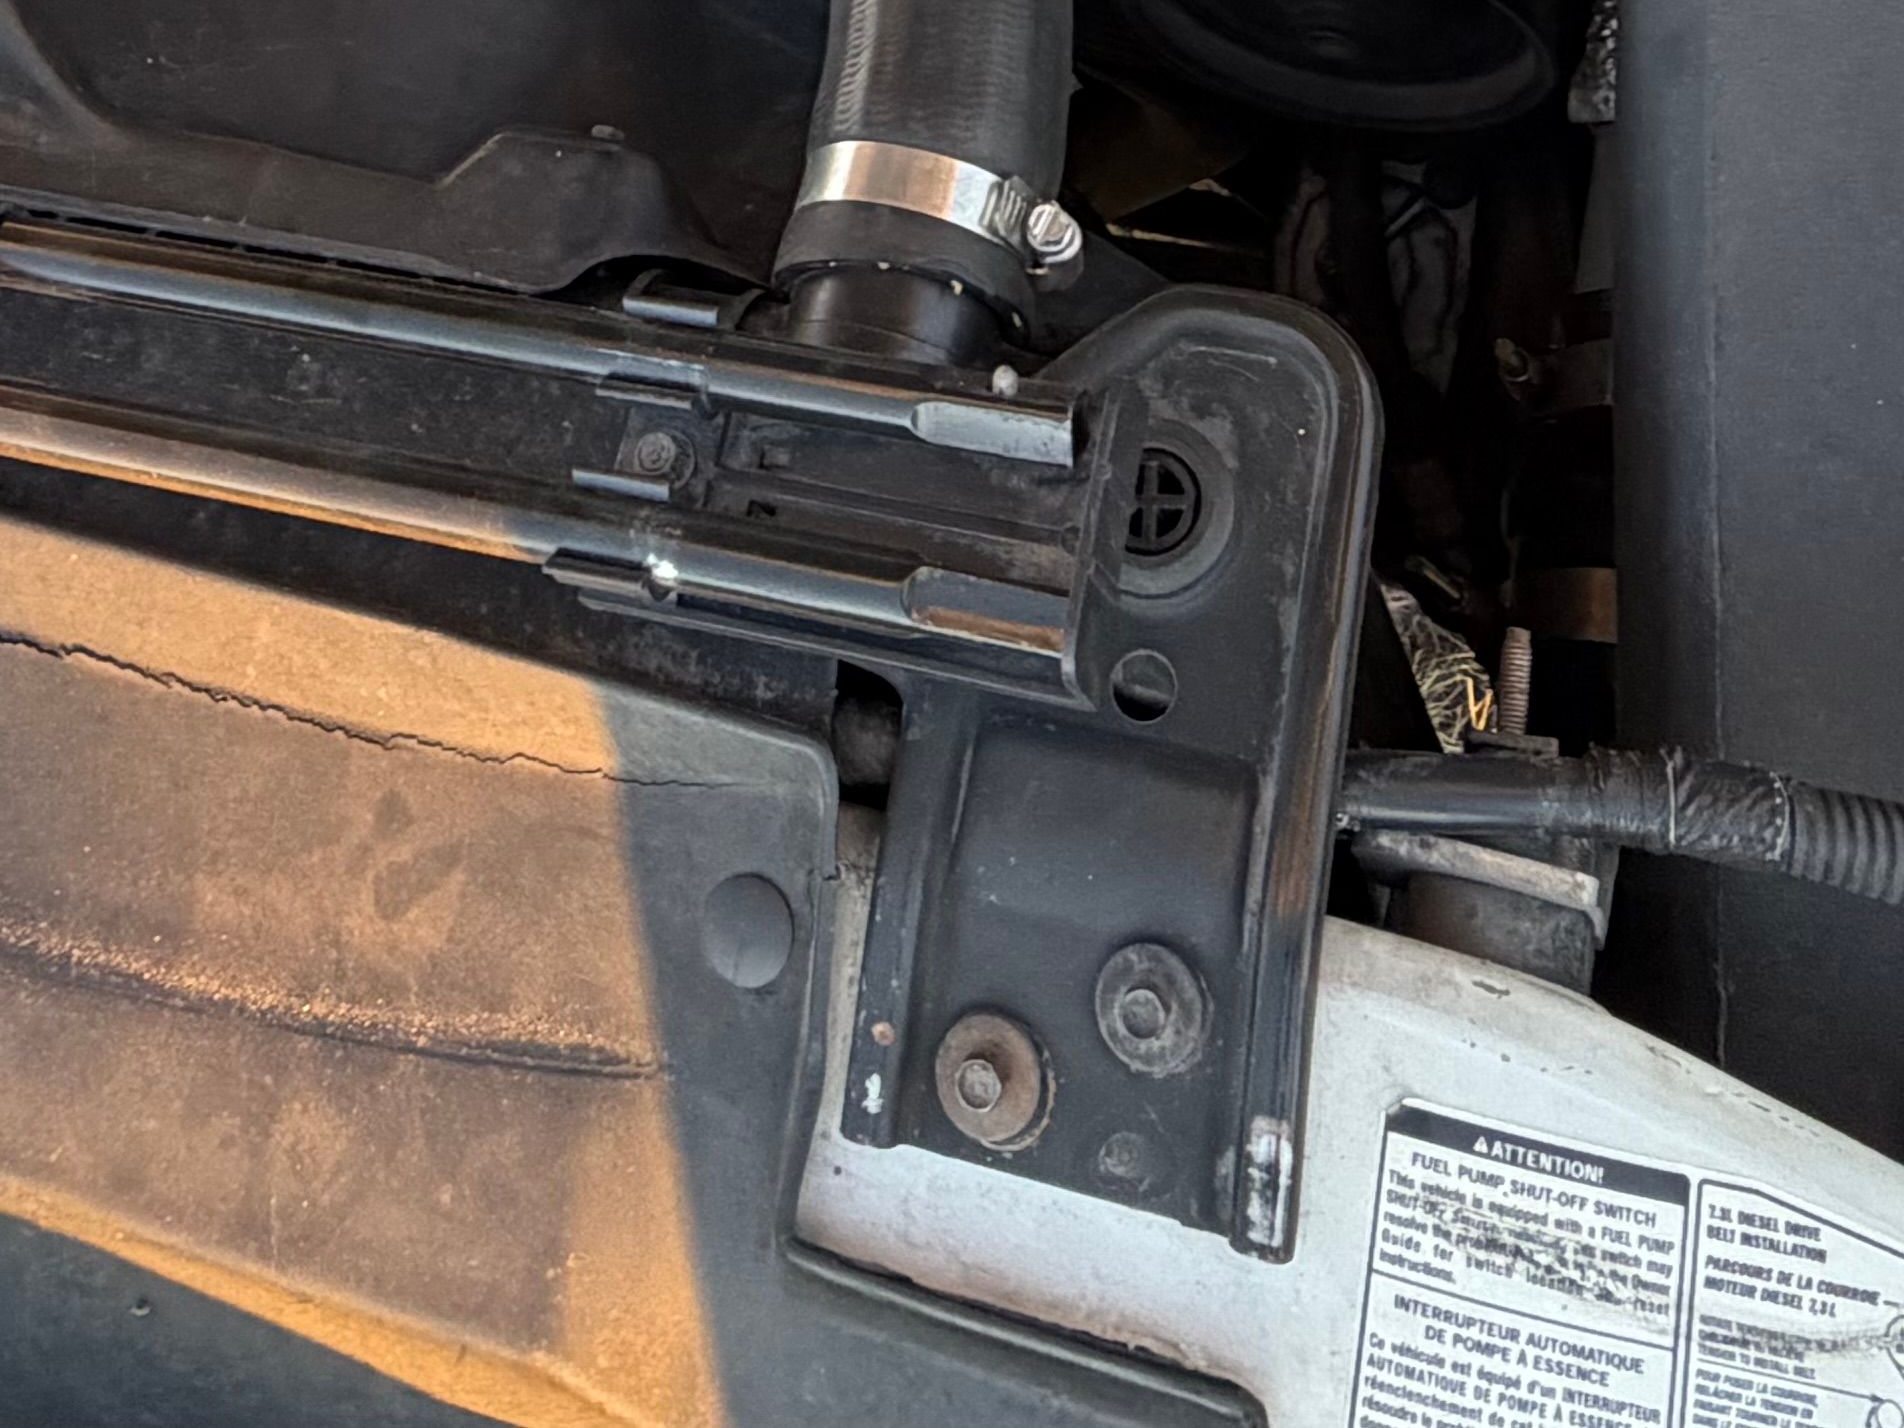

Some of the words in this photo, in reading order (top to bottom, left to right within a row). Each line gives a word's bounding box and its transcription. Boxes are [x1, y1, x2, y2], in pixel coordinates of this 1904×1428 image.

[1489, 1140, 1606, 1184] ATTENTION!
[1386, 1168, 1417, 1191] This
[1419, 1181, 1467, 1204] vehicle
[1470, 1194, 1485, 1209] is
[1487, 1199, 1550, 1228] equipped
[1553, 1214, 1584, 1235] with
[1599, 1225, 1633, 1247] FUEL
[1636, 1234, 1676, 1256] PUMP
[1409, 1152, 1454, 1175] FUEL
[1455, 1164, 1505, 1189] PUMP
[1508, 1179, 1589, 1211] SHUT-OFF
[1590, 1198, 1658, 1230] SWITCH
[1379, 1228, 1422, 1254] Guide
[1431, 1242, 1455, 1262] for
[1703, 1224, 1737, 1243] BELT
[1738, 1231, 1829, 1264] INSTALLATION
[1735, 1210, 1782, 1232] DIESEL
[1782, 1220, 1824, 1241] DRIVE
[1702, 1275, 1758, 1299] MOTEUR
[1759, 1287, 1805, 1310] DIESEL
[1703, 1254, 1774, 1283] PARCOURS
[1775, 1271, 1794, 1286] DE
[1794, 1275, 1815, 1291] LA
[1392, 1293, 1523, 1345] INTERRUPTEUR
[1525, 1331, 1646, 1375] AUTOMATIQUE
[1423, 1324, 1448, 1345] DE
[1450, 1333, 1512, 1363] POMPE
[1515, 1348, 1531, 1368] À
[1532, 1354, 1611, 1388] ESSENCE
[1365, 1352, 1469, 1397] AUTOMATIQUE
[1472, 1385, 1492, 1403] DE
[1496, 1391, 1549, 1419] POMPE
[1560, 1386, 1662, 1424] INTERRUPTEUR
